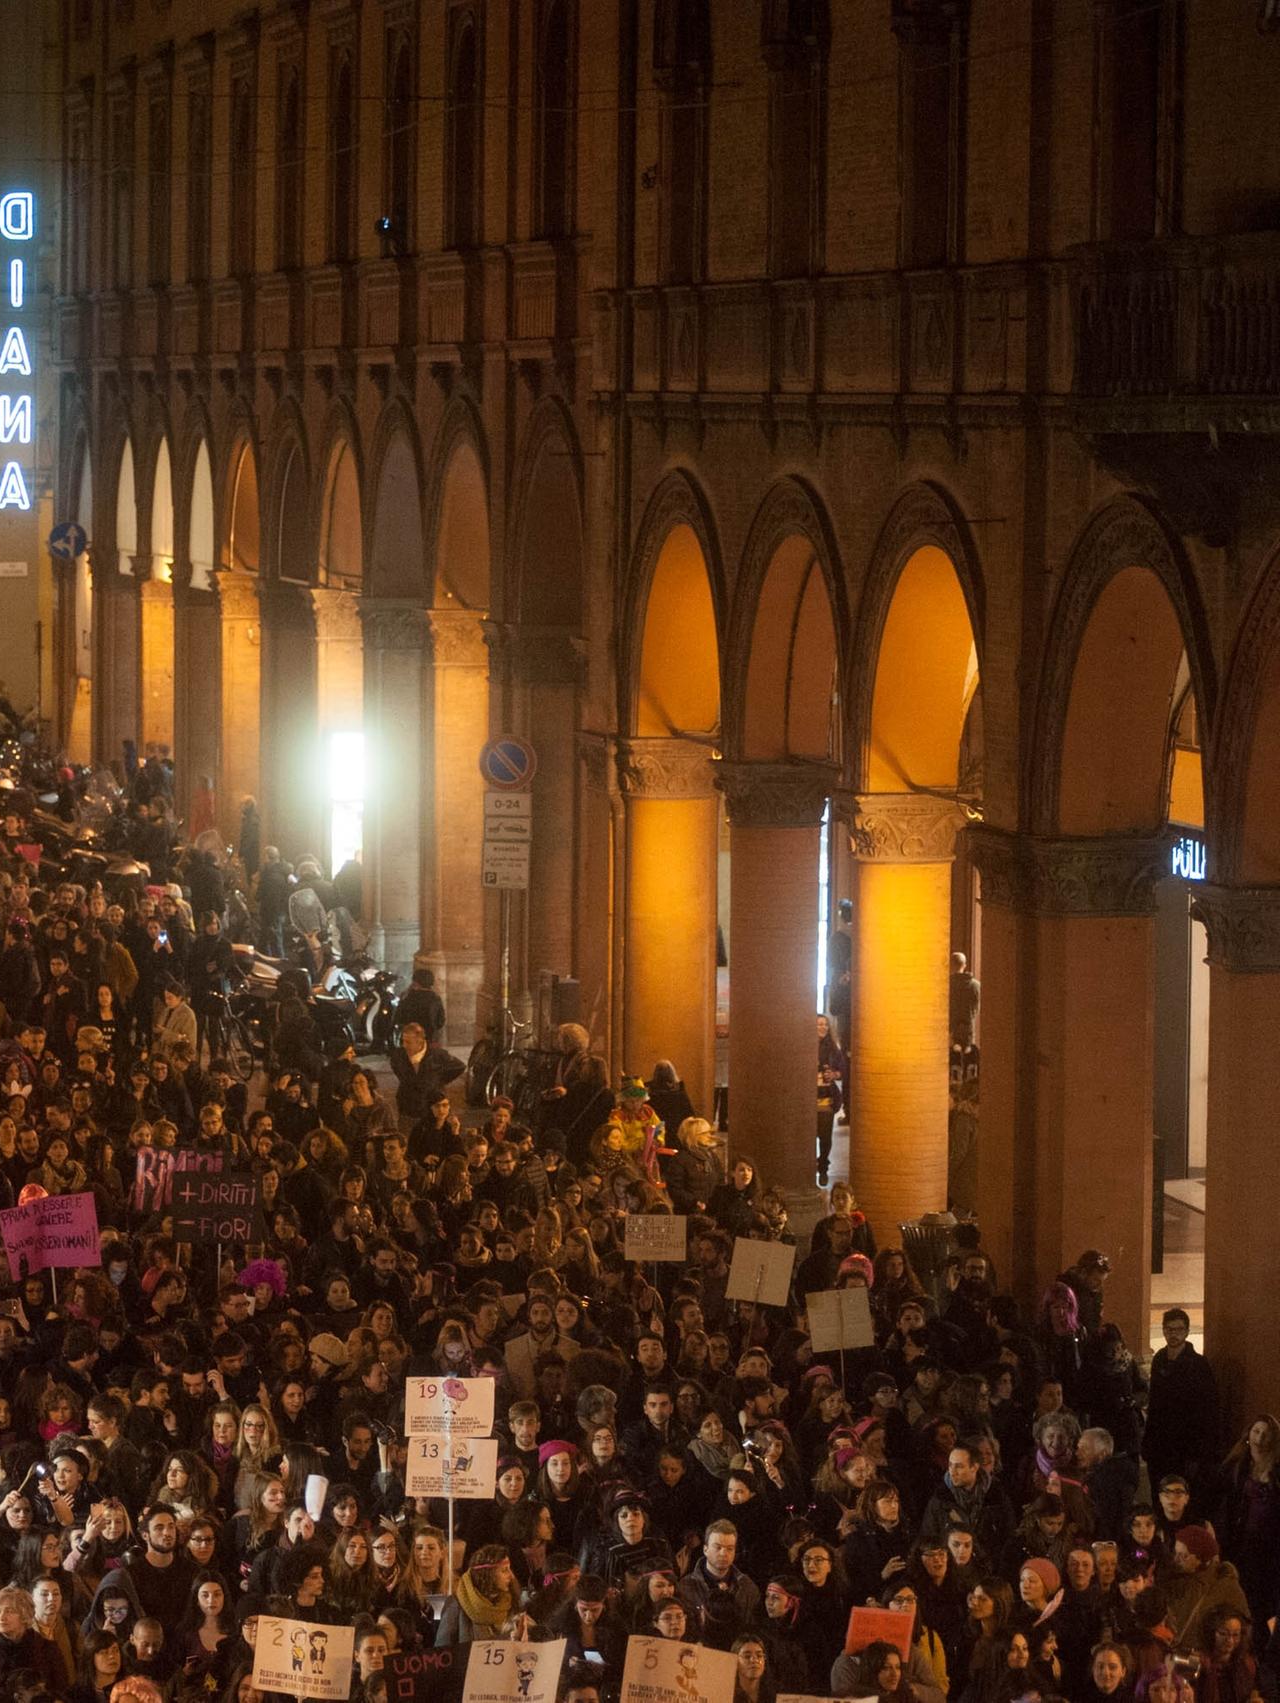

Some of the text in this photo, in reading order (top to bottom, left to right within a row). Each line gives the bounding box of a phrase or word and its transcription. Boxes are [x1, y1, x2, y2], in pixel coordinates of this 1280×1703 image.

[494, 799, 520, 809] 0-24
[419, 1383, 438, 1399] 19
[420, 1444, 439, 1458] 13
[272, 1628, 284, 1647] 2
[393, 1651, 453, 1676] UOMO
[484, 1648, 505, 1665] 15
[644, 1648, 659, 1670] 5
